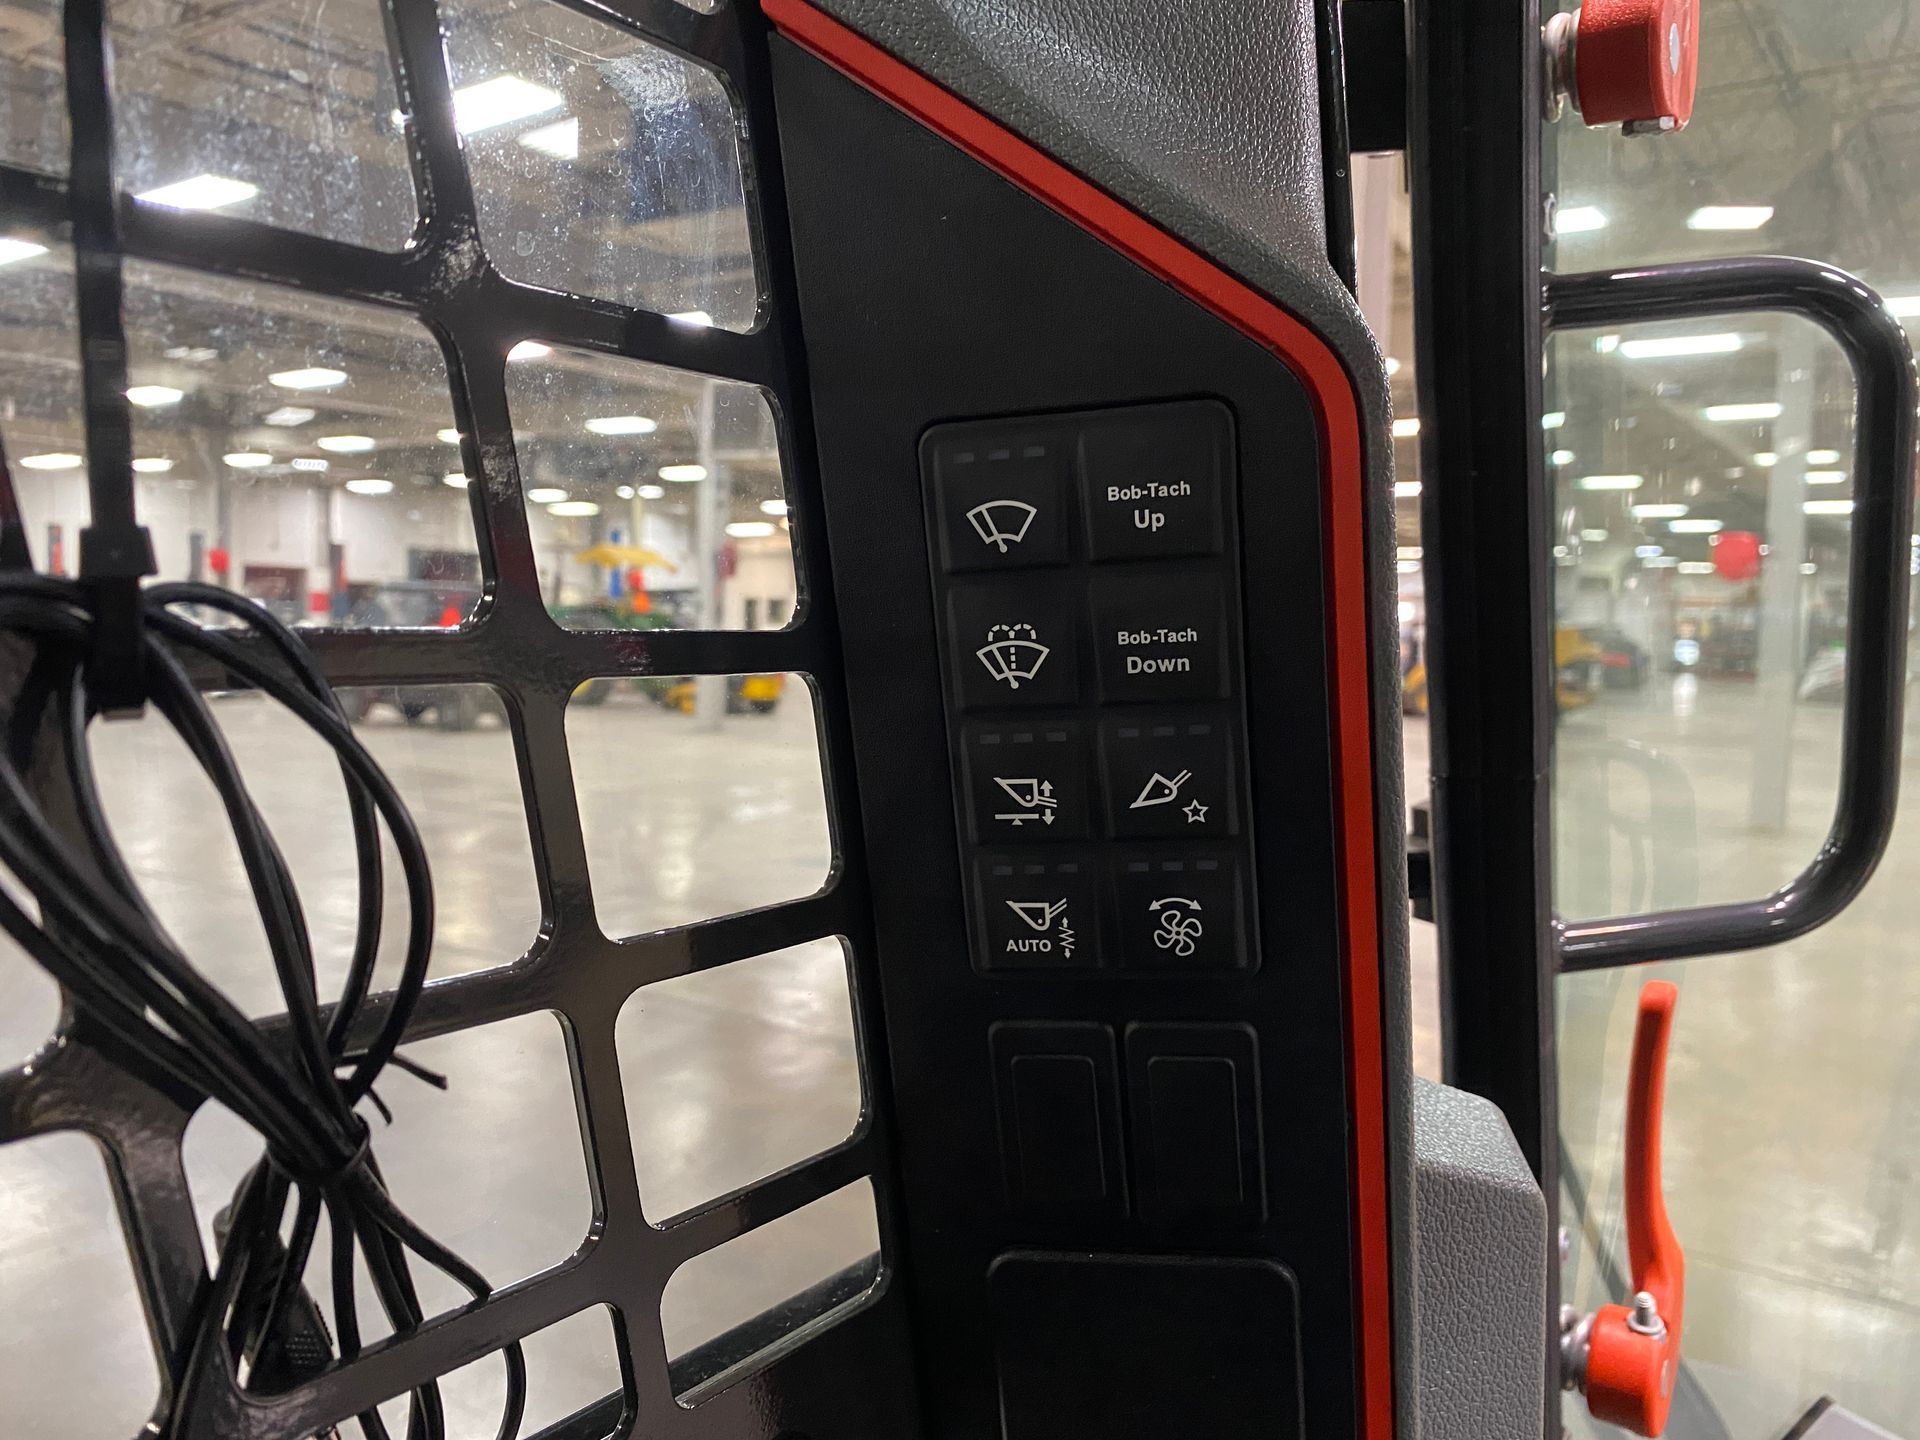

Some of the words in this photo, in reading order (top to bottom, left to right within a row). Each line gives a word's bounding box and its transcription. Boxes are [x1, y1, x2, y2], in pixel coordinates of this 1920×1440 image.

[1107, 481, 1191, 501] Bob-Tach
[1134, 508, 1165, 531] Up
[1117, 628, 1198, 645] Bob-Tach
[1126, 656, 1190, 674] Down
[1006, 939, 1052, 952] AUTO
